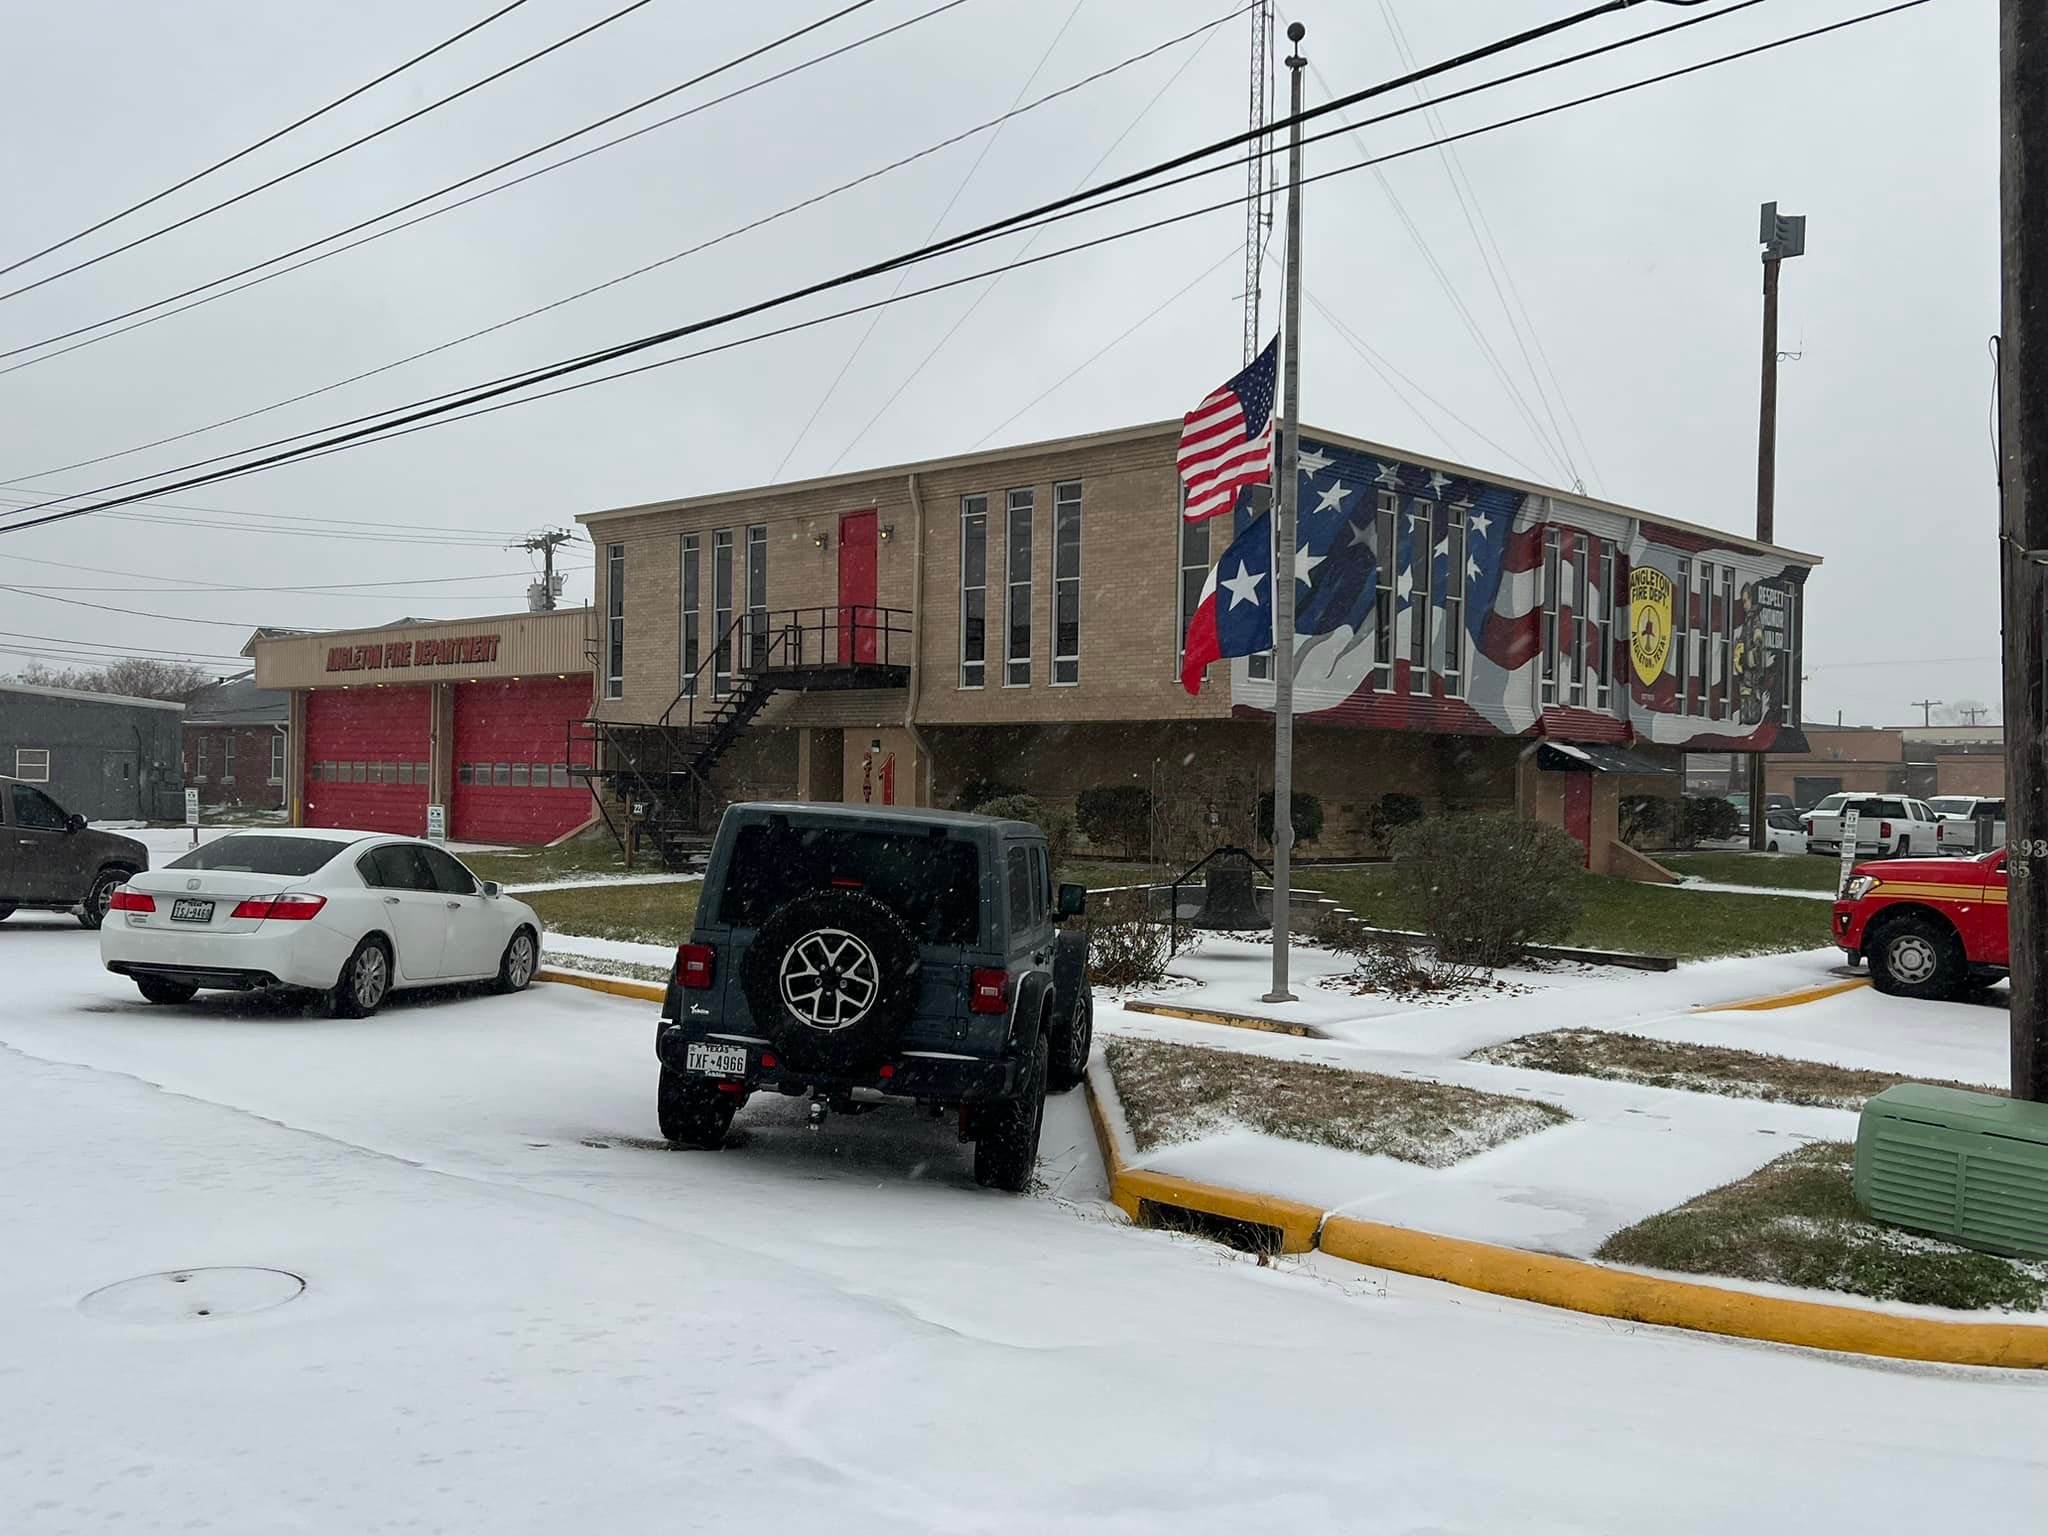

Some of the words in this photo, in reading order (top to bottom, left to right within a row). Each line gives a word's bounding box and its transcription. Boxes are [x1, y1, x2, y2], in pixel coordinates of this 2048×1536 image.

[1631, 569, 1670, 597] ANGLETON
[1632, 585, 1648, 603] FIRE
[1758, 585, 1784, 608] RESPECT
[1763, 630, 1784, 649] VALOR
[326, 645, 383, 672] ANGLETON
[384, 640, 412, 669] FIRE
[414, 634, 500, 666] DEPARTMENT
[2010, 859, 2030, 879] 65
[706, 1045, 729, 1053] TEXAS
